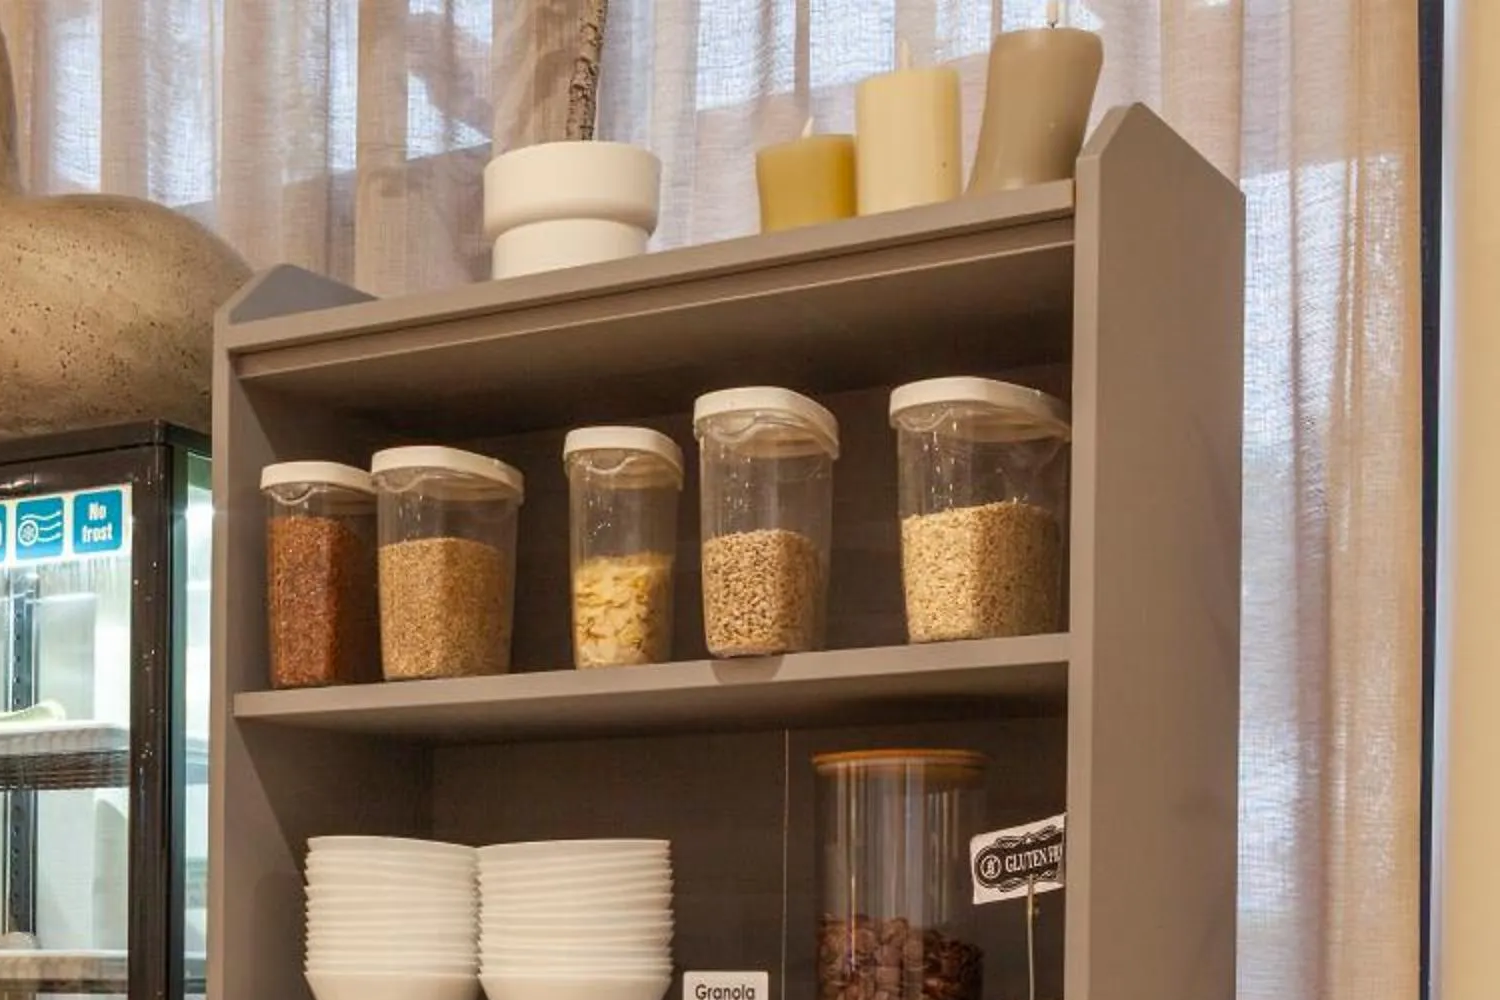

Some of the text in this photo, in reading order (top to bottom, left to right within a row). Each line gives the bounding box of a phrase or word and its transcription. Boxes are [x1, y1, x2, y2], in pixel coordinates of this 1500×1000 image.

[88, 502, 107, 521] No
[1005, 849, 1047, 873] GLUTEN
[695, 983, 755, 1000] Granola
